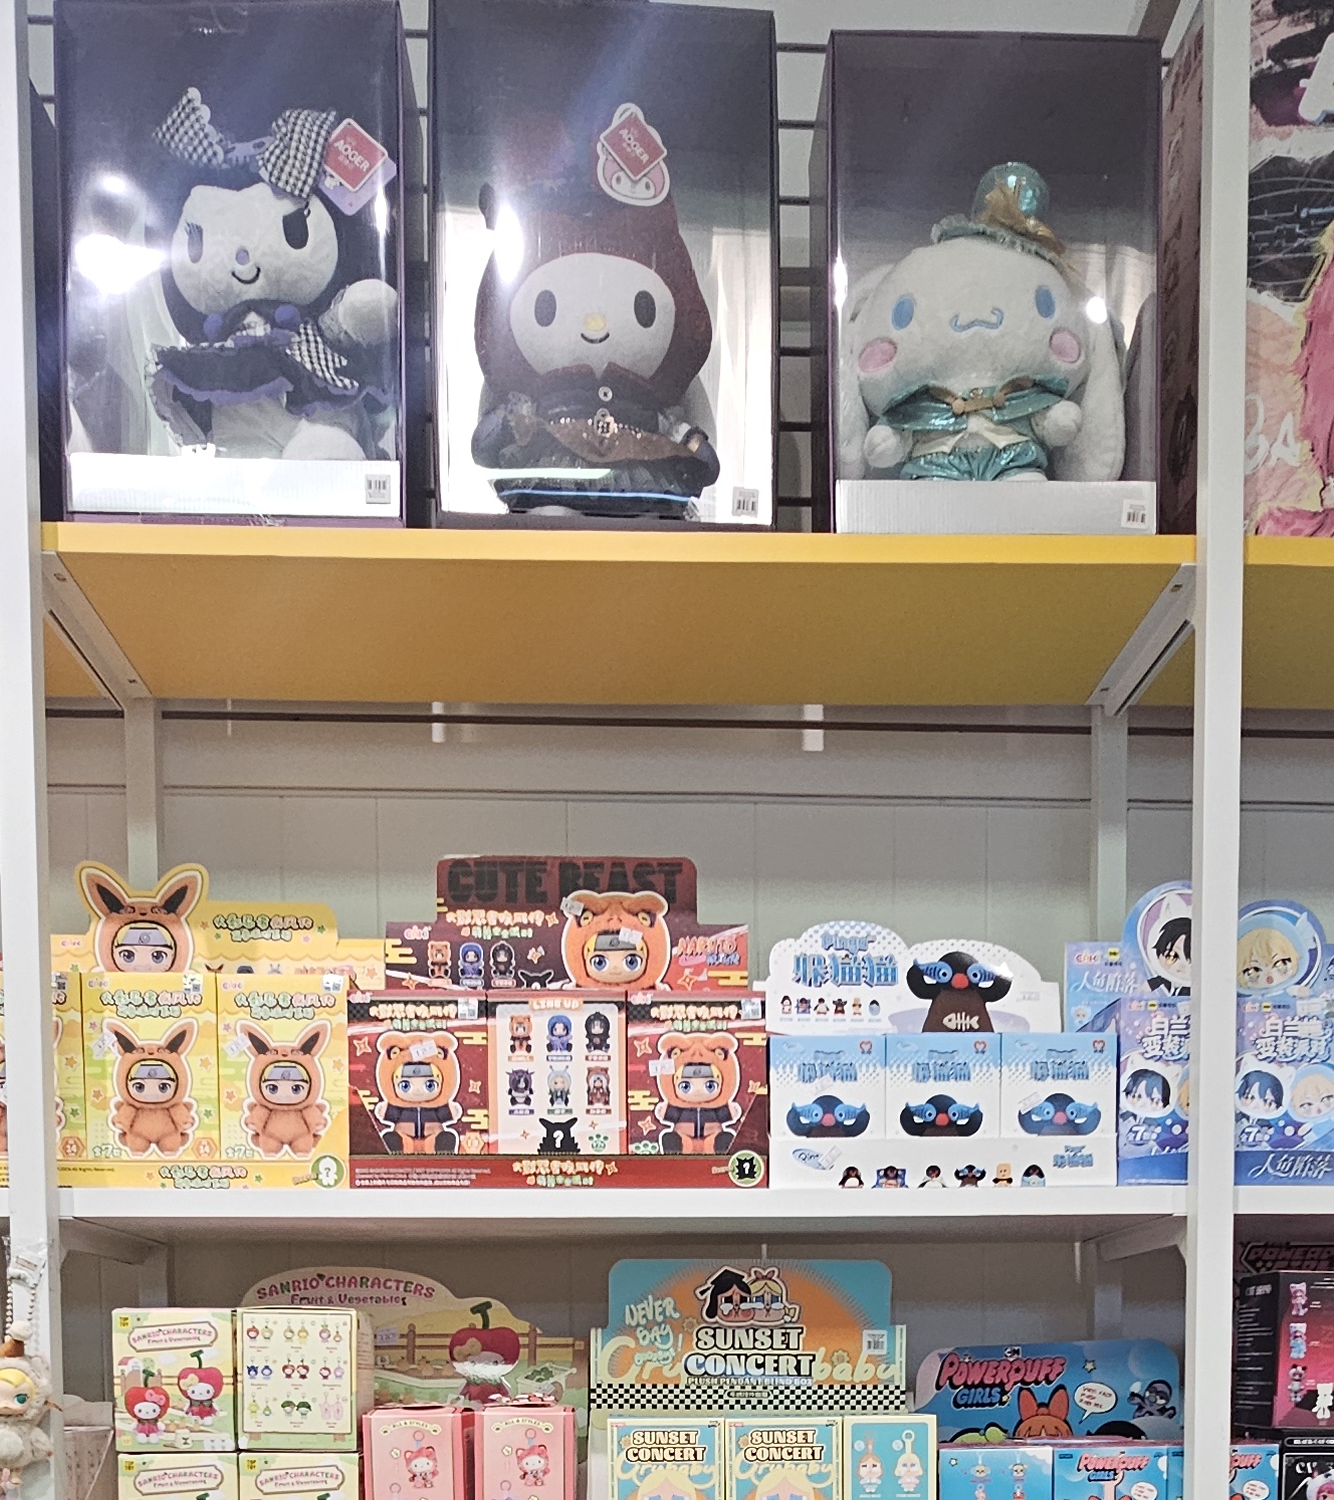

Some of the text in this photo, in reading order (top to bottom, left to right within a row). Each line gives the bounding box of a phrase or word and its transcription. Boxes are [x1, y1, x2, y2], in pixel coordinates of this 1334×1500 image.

[334, 138, 371, 173] AOGER
[447, 859, 547, 904] CUTE
[677, 934, 738, 955] NARUTO
[256, 1274, 436, 1300] SANRIO CHARACTERS
[290, 1294, 326, 1307] Fruit
[337, 1293, 408, 1307] Vegetables
[625, 1297, 680, 1327] NEVER
[131, 1327, 214, 1344] SANRIO CHARACTERS
[636, 1325, 673, 1349] SAY
[696, 1326, 804, 1350] SUNSET
[684, 1353, 816, 1378] CONCERT
[935, 1353, 1067, 1391] POWERPUFF
[952, 1387, 1003, 1409] GIRLS
[633, 1429, 698, 1447] SUNSET
[750, 1429, 816, 1446] SUNSET
[626, 1446, 706, 1463] CONCERT
[744, 1445, 824, 1462] CONCERT
[1077, 1452, 1151, 1473] POWERPUFF
